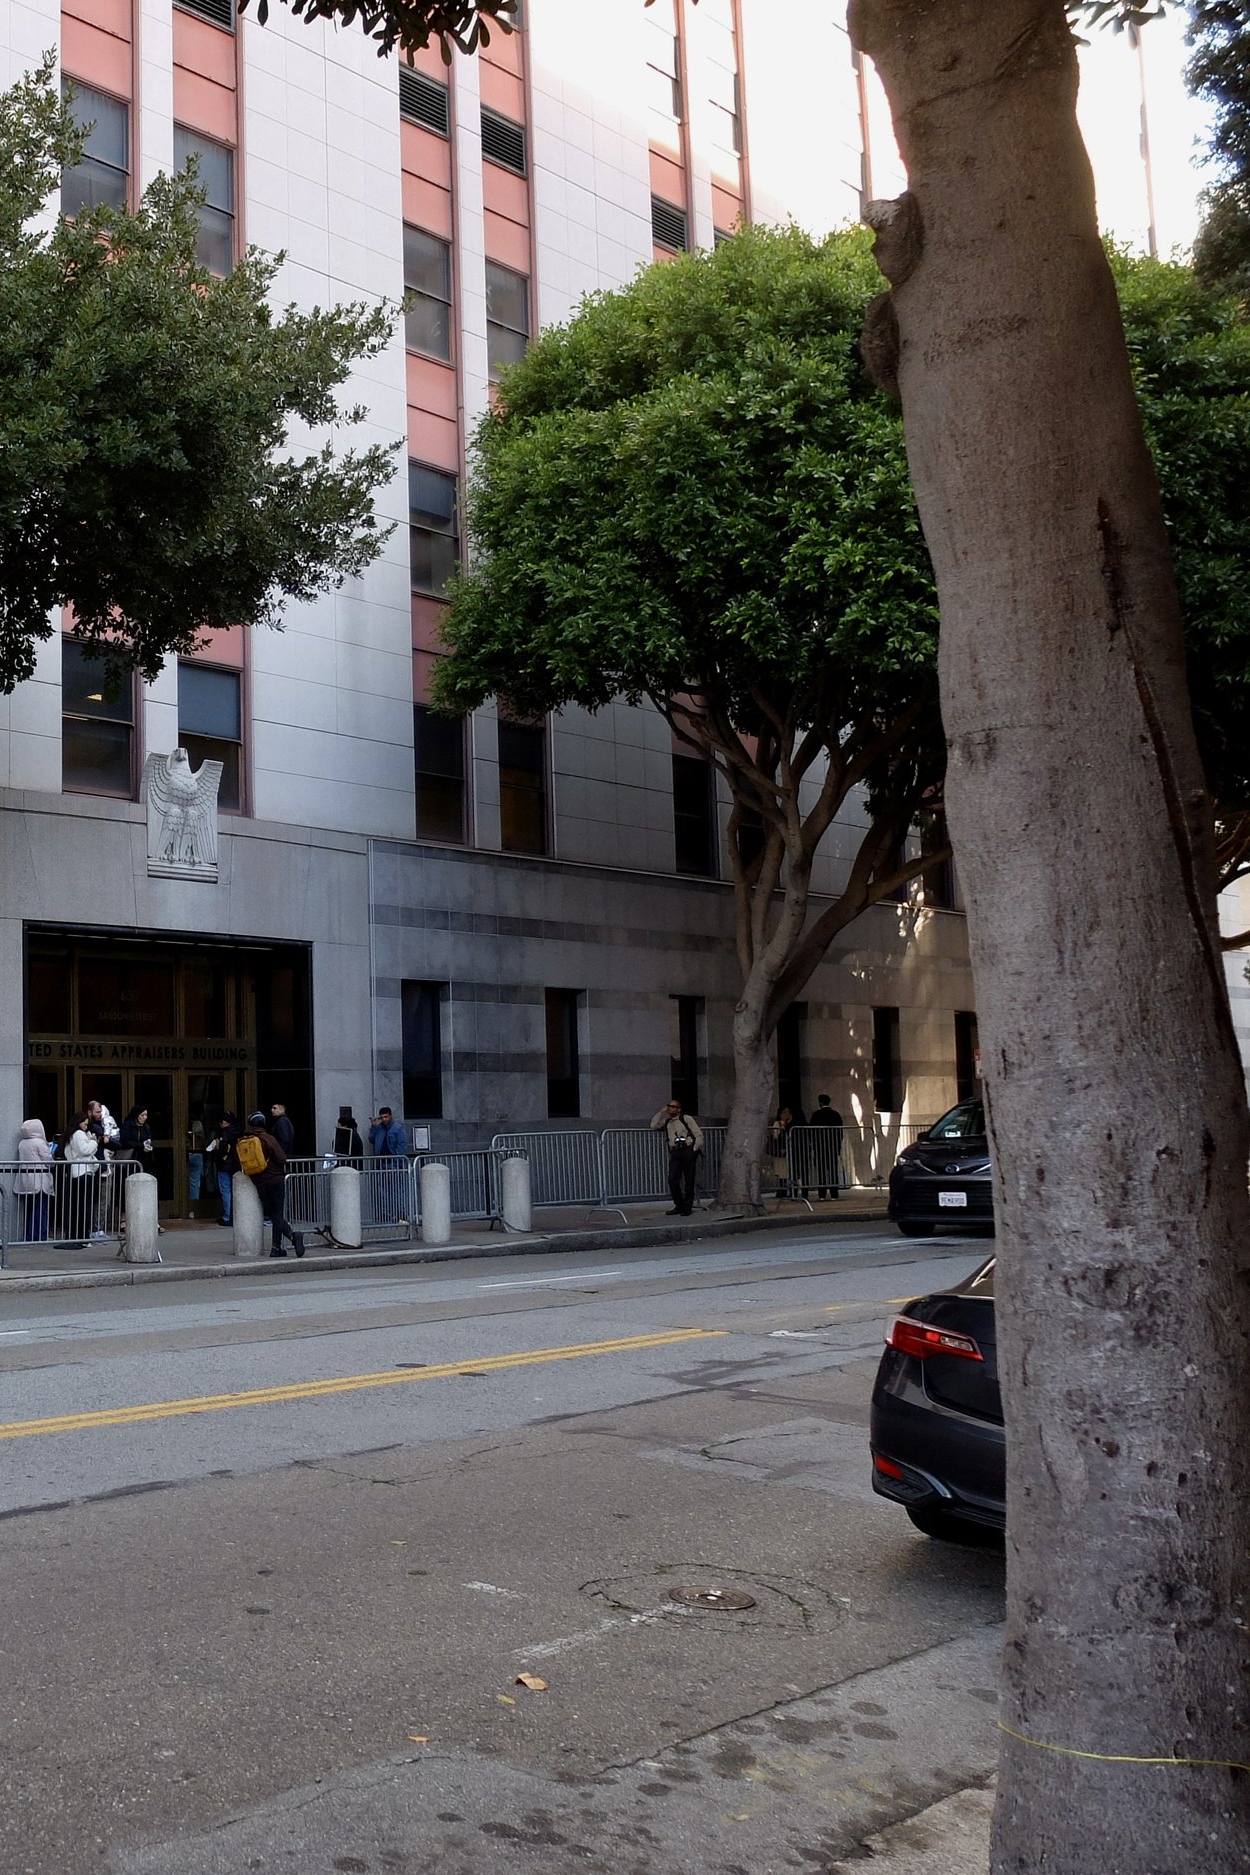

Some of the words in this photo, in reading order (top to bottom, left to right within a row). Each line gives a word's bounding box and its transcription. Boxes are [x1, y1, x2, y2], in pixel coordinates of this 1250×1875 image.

[29, 1043, 52, 1057] TED
[59, 1044, 103, 1058] STATES
[110, 1045, 185, 1060] APPRAISERS
[192, 1047, 247, 1061] BUILDING
